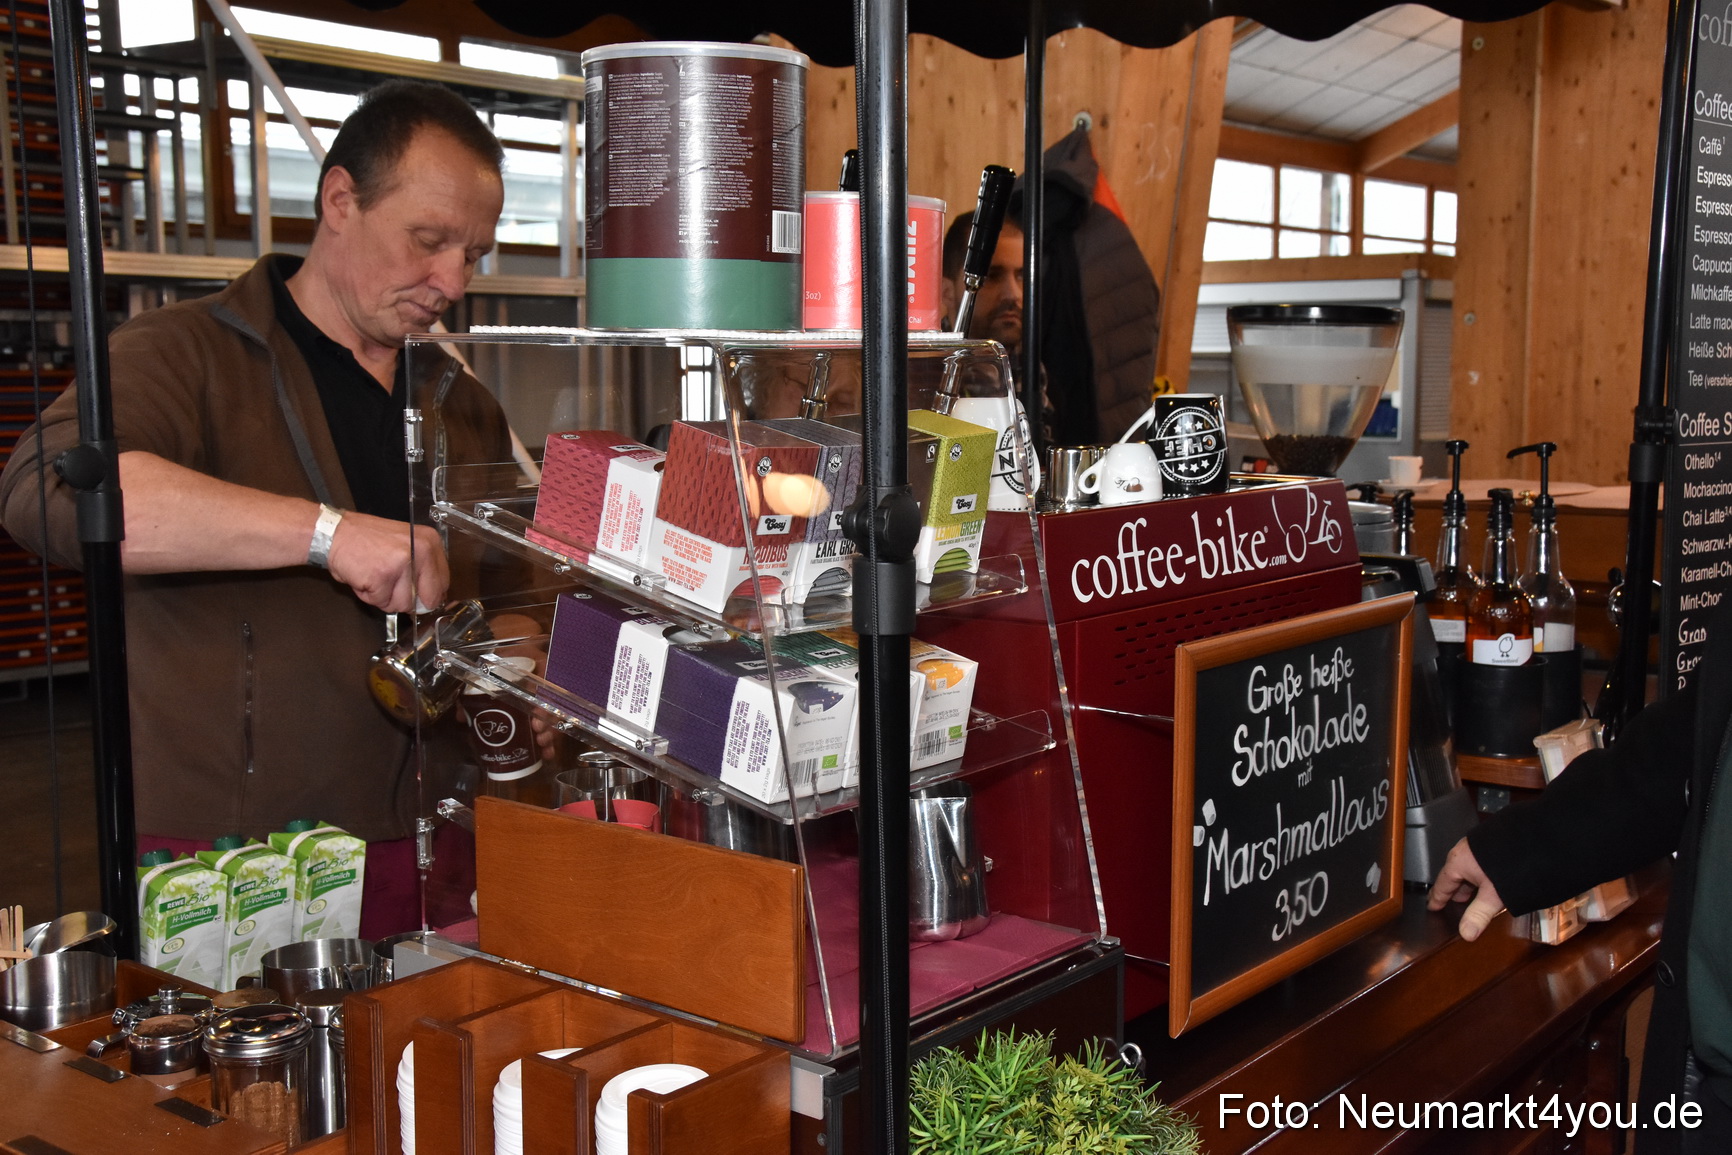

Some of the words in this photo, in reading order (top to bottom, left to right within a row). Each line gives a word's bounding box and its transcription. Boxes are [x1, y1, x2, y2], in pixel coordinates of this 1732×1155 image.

[1690, 312, 1711, 330] Latte
[1713, 317, 1732, 330] mac
[1689, 342, 1714, 358] Heiße
[1688, 370, 1703, 387] Tee
[1680, 412, 1720, 437] Coffee
[1164, 434, 1217, 458] CHEF
[765, 517, 786, 532] Cosy
[1682, 509, 1703, 527] Chai
[960, 519, 983, 536] GREEN
[816, 541, 838, 558] EARL
[1071, 506, 1269, 603] coffee-bike
[1248, 663, 1303, 716] Große
[1310, 646, 1354, 694] heiße
[1231, 682, 1370, 787] Schokolade
[1297, 758, 1314, 788] mit
[1203, 776, 1390, 906] Marshmallows
[327, 857, 349, 869] Bio
[257, 876, 280, 889] Bio
[315, 871, 351, 887] H-Vollmilch
[167, 899, 185, 910] REWE
[186, 892, 210, 906] Bio
[244, 891, 282, 906] H-Vollmilch
[1271, 871, 1329, 942] 3,50
[172, 908, 212, 923] H-Vollmilch
